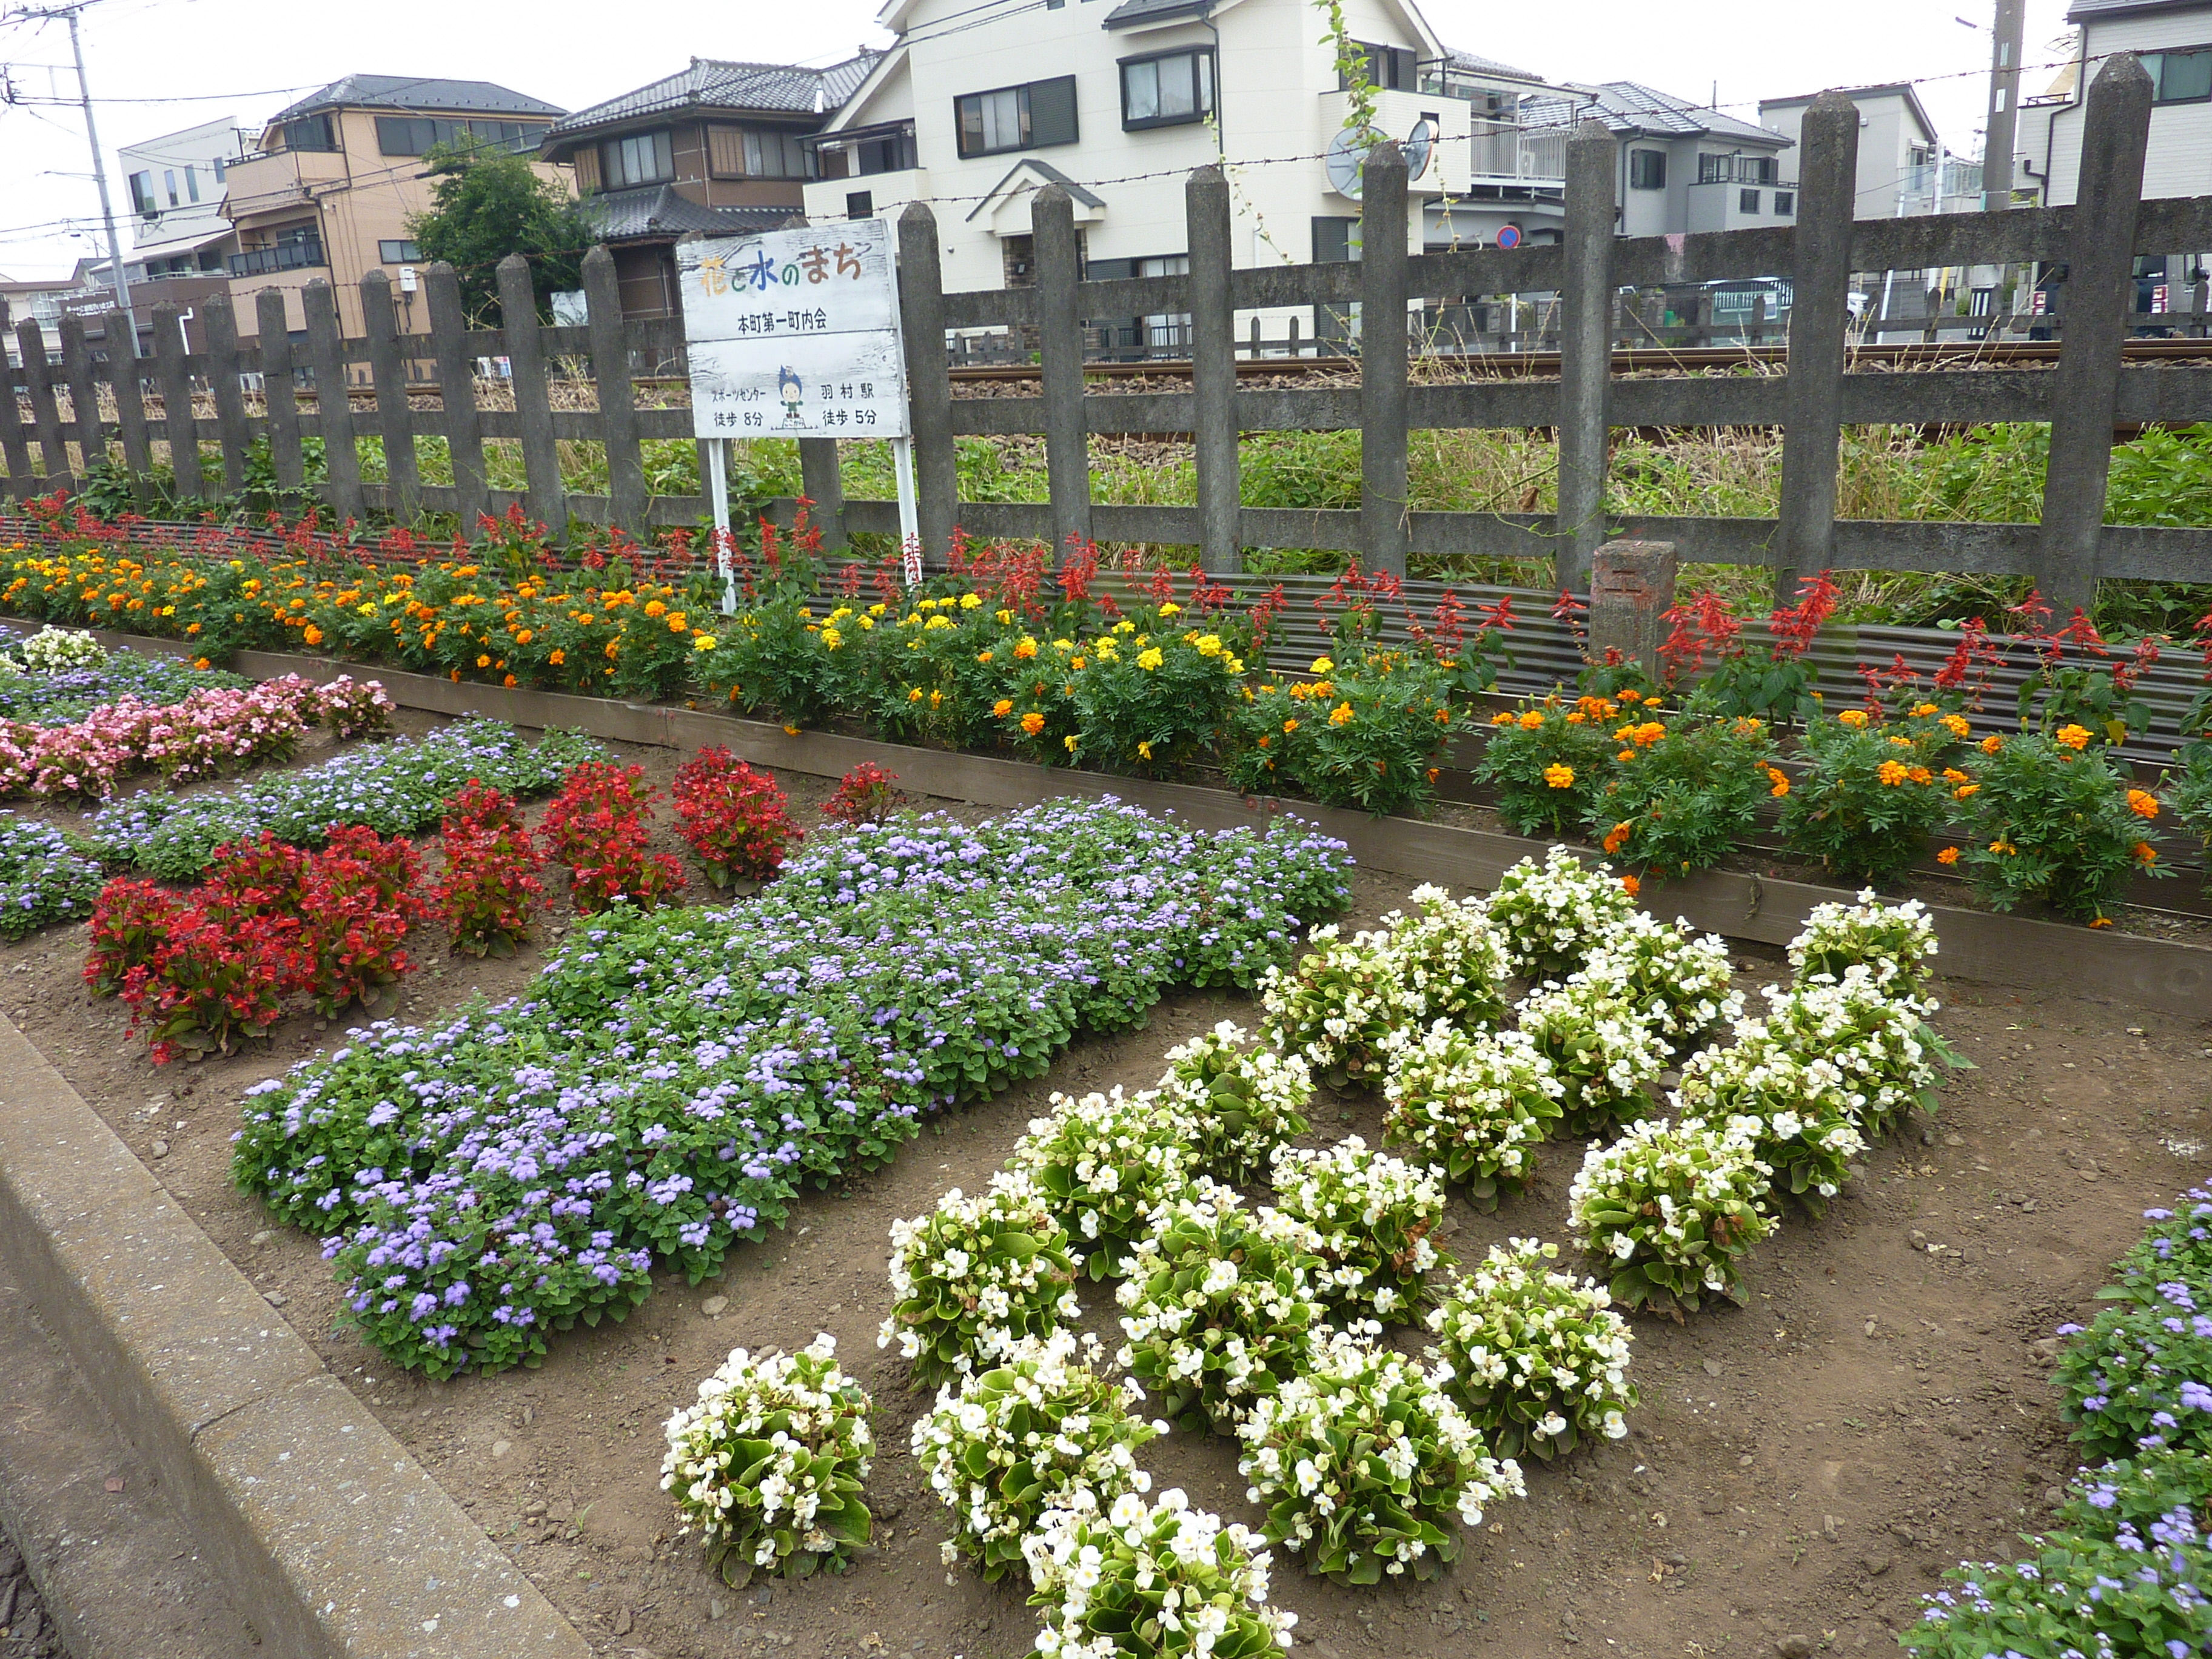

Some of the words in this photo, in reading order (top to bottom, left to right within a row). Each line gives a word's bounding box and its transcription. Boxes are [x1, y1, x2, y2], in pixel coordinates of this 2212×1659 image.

[700, 241, 862, 297] 花と水のまち
[737, 307, 826, 335] 本町第一町内会
